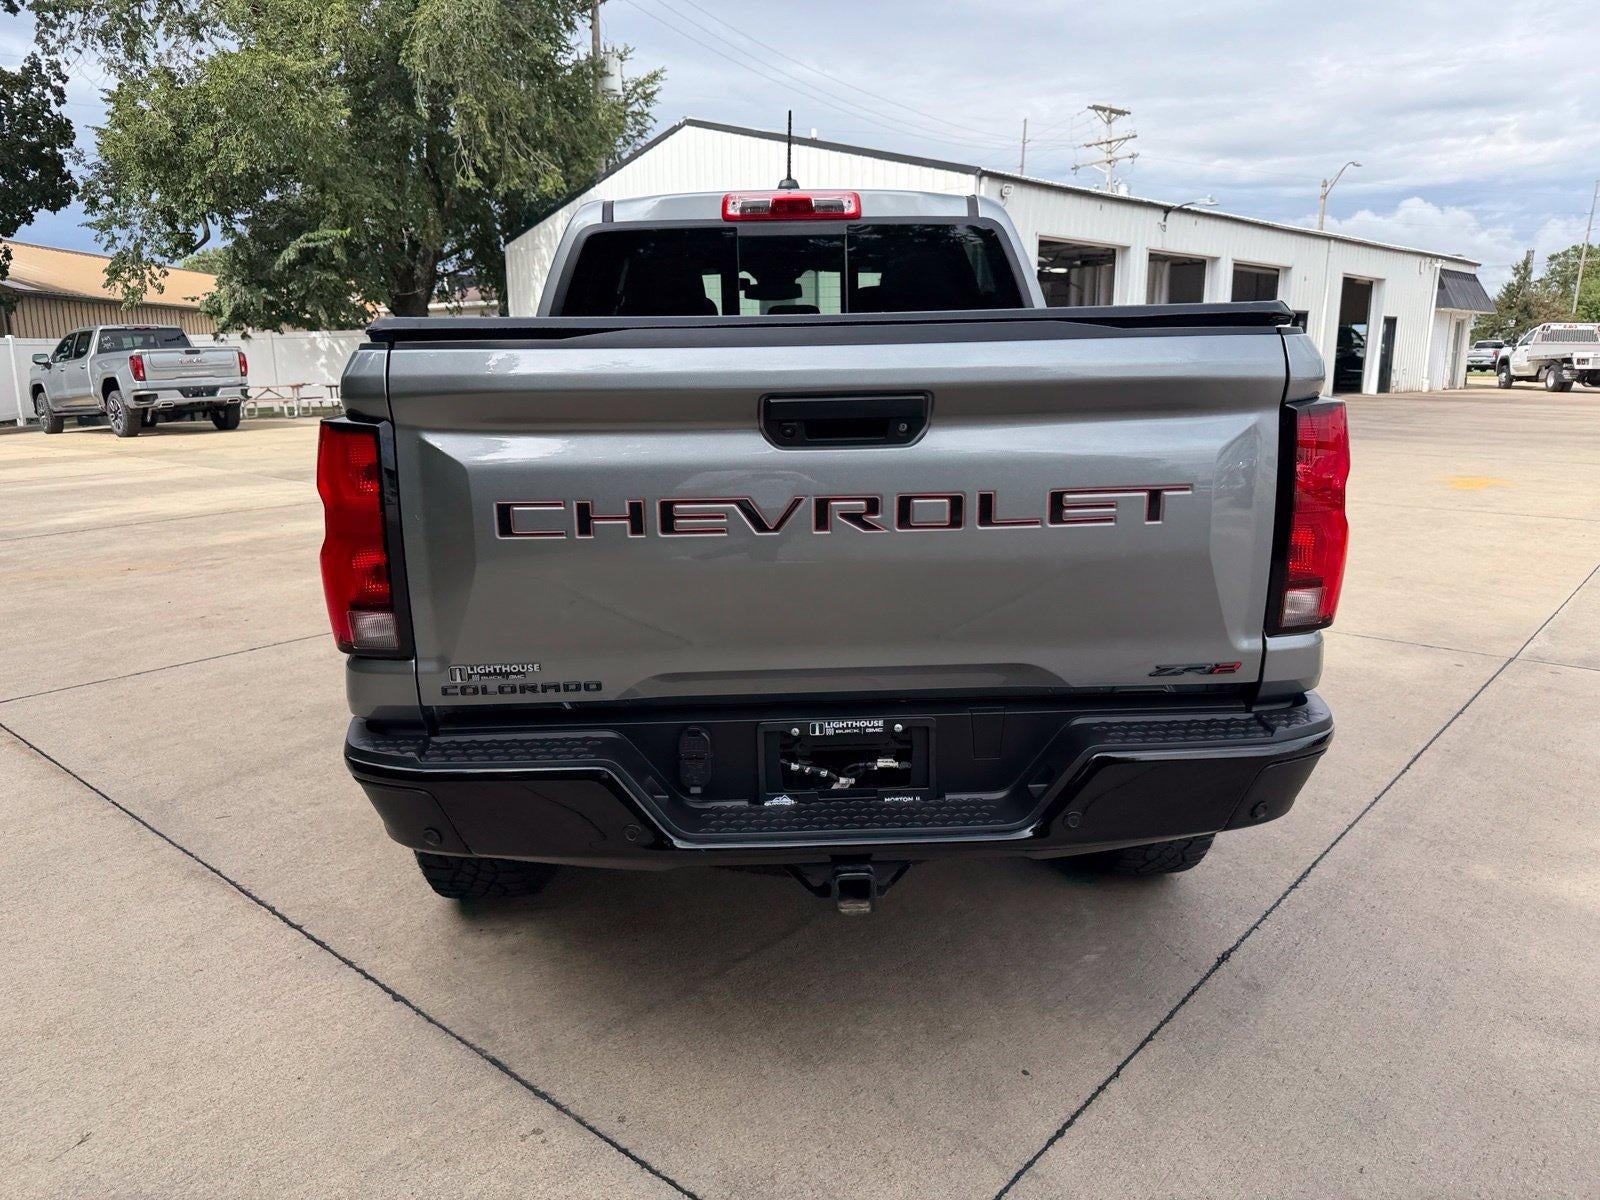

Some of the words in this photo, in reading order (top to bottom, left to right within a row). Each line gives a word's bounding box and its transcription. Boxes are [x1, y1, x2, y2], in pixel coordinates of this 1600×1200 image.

[495, 484, 1193, 539] CHEVROLET
[467, 663, 540, 673] LIGHTHOUSE
[1148, 662, 1242, 677] ZR2
[441, 681, 602, 696] COLORADO
[825, 720, 884, 728] LIGHTHOUSE
